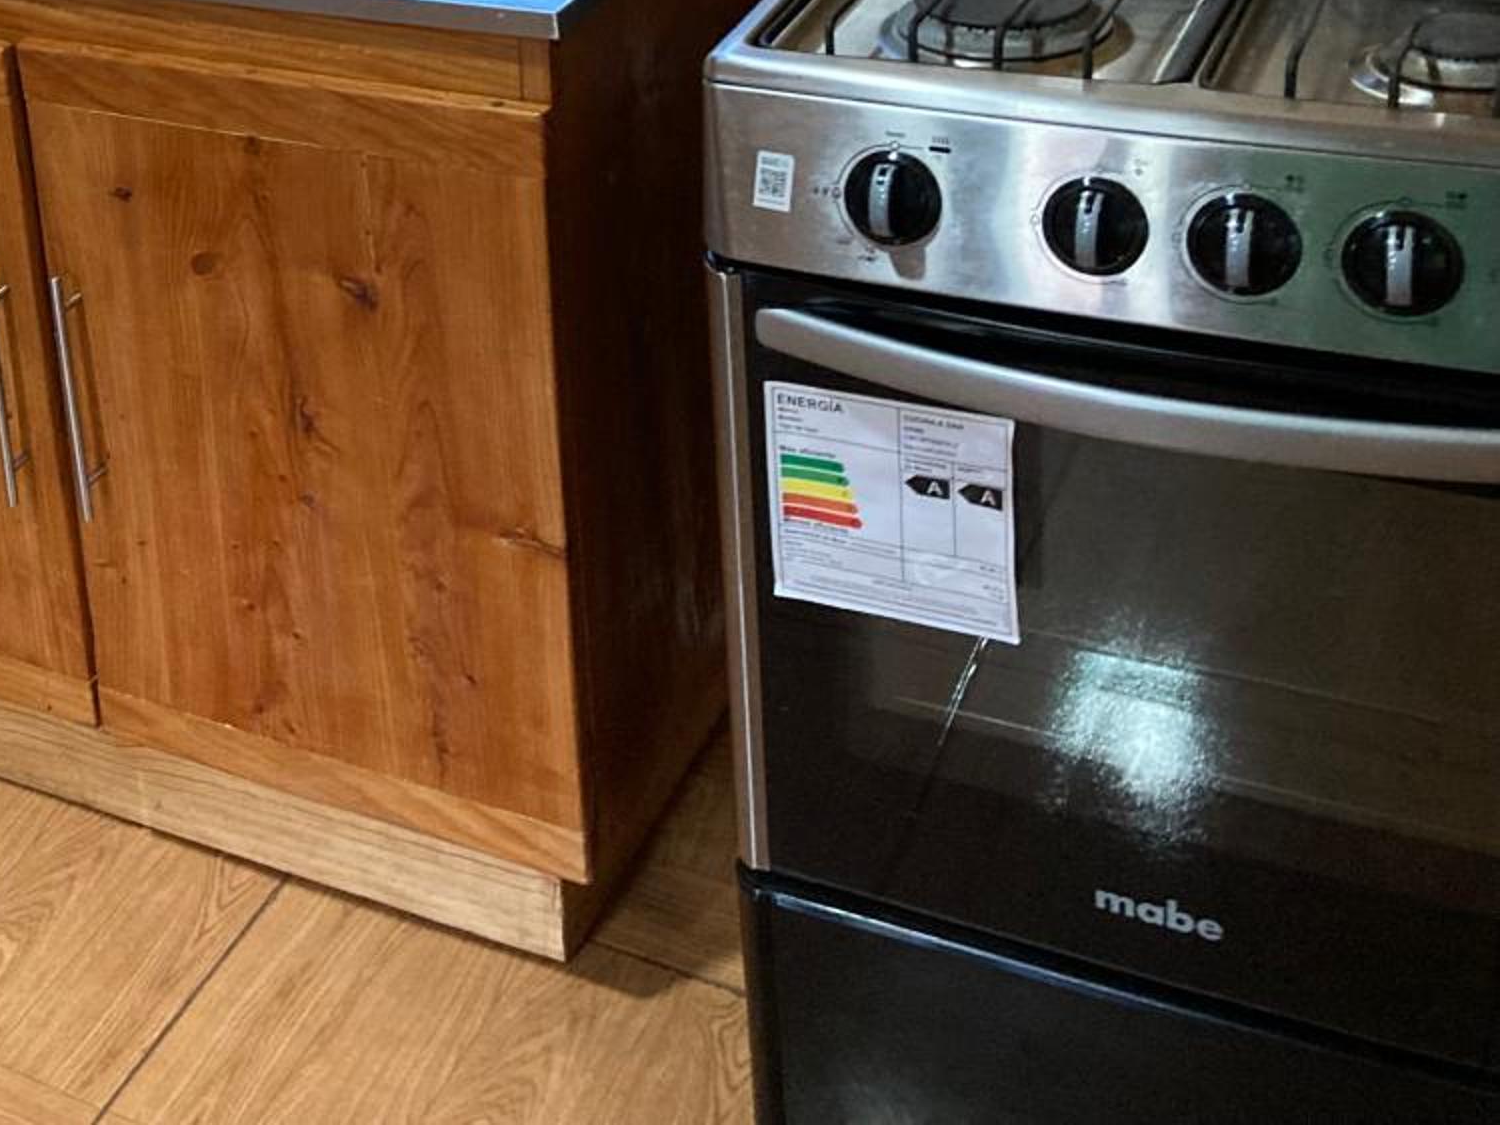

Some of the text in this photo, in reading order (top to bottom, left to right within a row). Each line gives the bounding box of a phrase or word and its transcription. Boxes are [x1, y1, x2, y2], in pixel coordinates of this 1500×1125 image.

[777, 393, 844, 413] ENERGÍA
[927, 481, 942, 496] A
[981, 490, 996, 506] A
[1095, 889, 1223, 941] mabe
